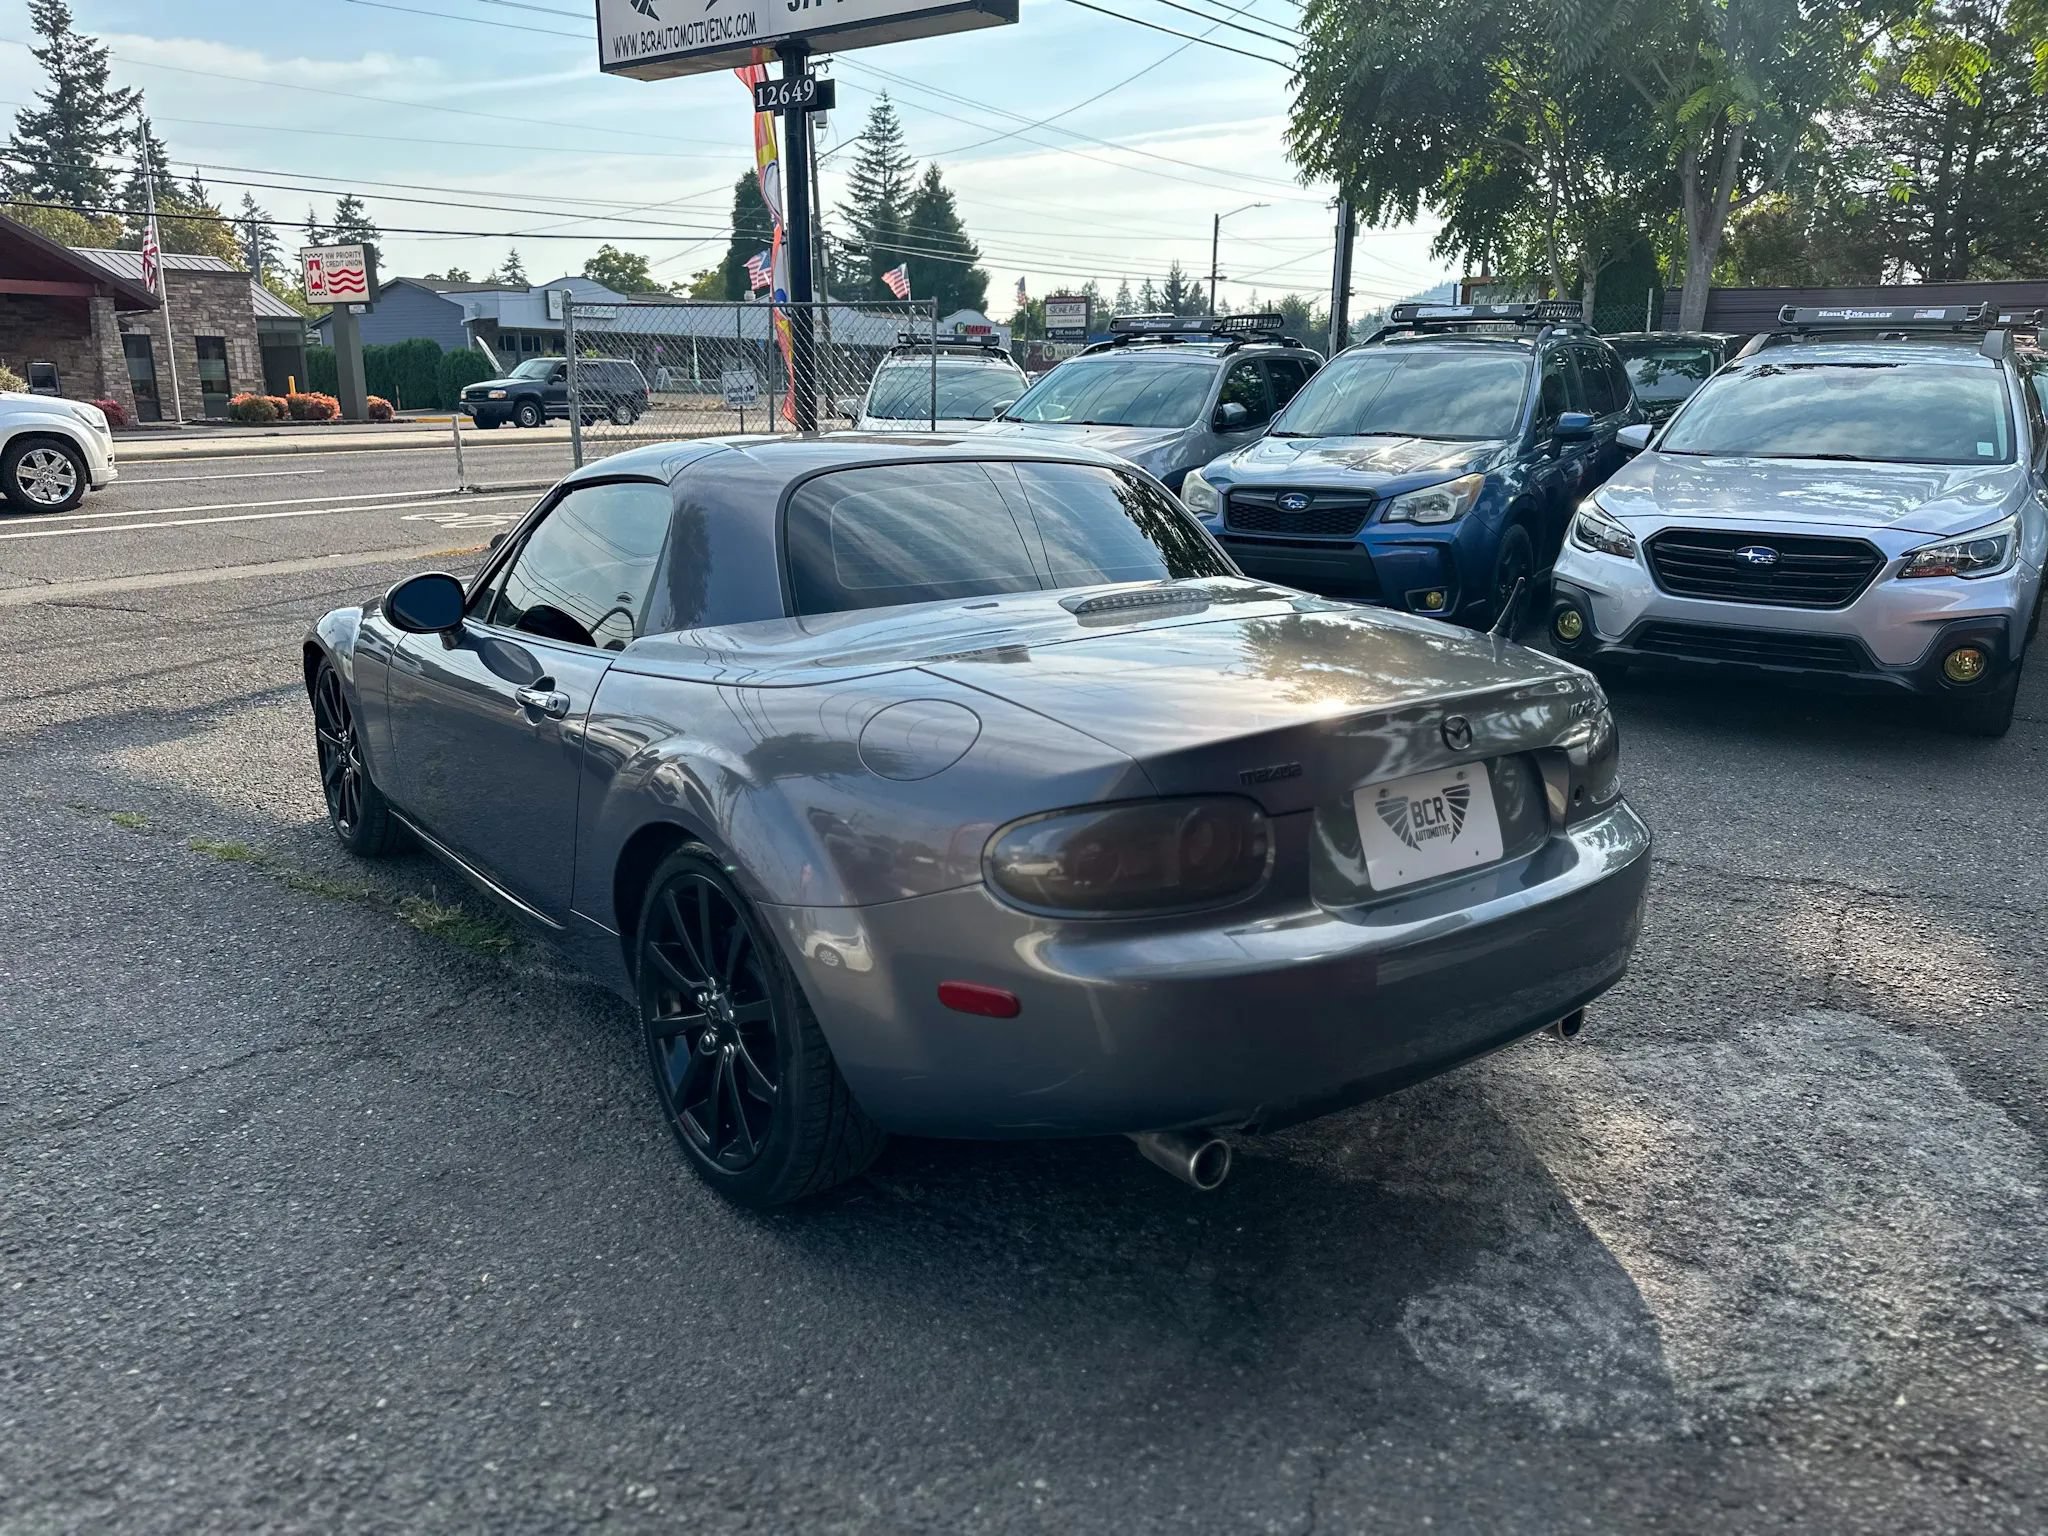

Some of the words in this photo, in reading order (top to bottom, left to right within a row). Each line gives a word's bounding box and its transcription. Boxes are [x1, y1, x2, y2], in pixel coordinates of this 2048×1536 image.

[613, 11, 757, 58] WWW.BCRAUTOMOTIVEINC.COM
[757, 79, 814, 107] 12649
[336, 251, 361, 259] PRIORITY
[345, 259, 362, 267] UNION
[1410, 797, 1446, 829] BCR
[1415, 824, 1452, 842] AUTOMOTIVE
